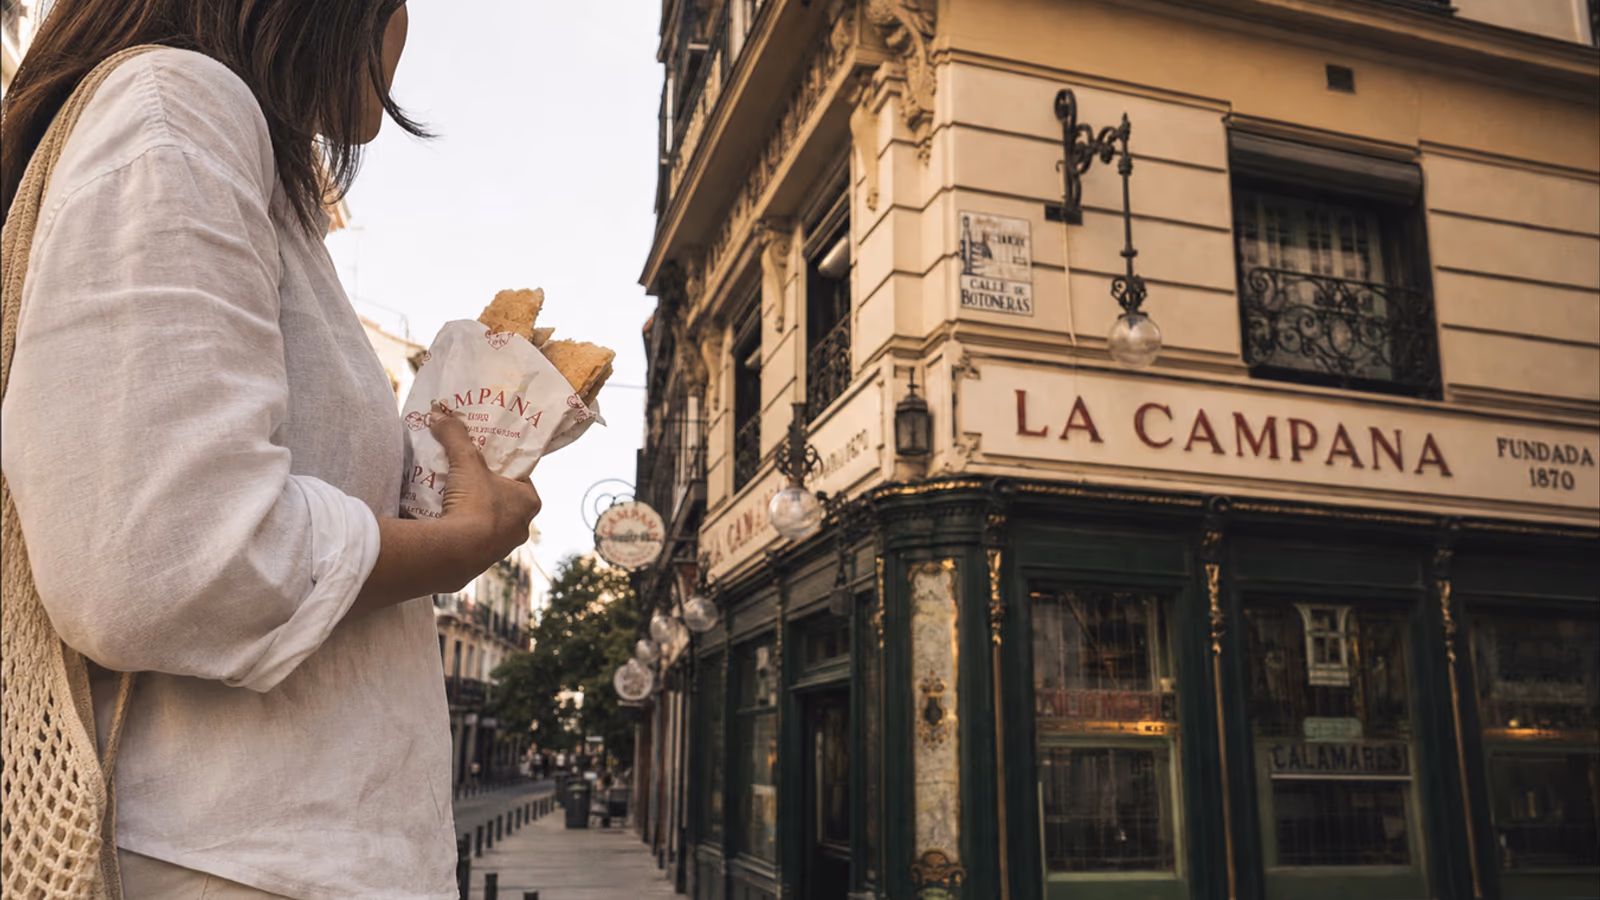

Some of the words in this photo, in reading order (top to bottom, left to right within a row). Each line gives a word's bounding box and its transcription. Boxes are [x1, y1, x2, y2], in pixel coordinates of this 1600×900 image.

[961, 288, 1030, 312] BOTONERAS
[1014, 389, 1104, 443] LA
[1134, 402, 1453, 477] CAMPANA
[1496, 437, 1595, 466] FUNDADA
[1530, 467, 1576, 490] 1870
